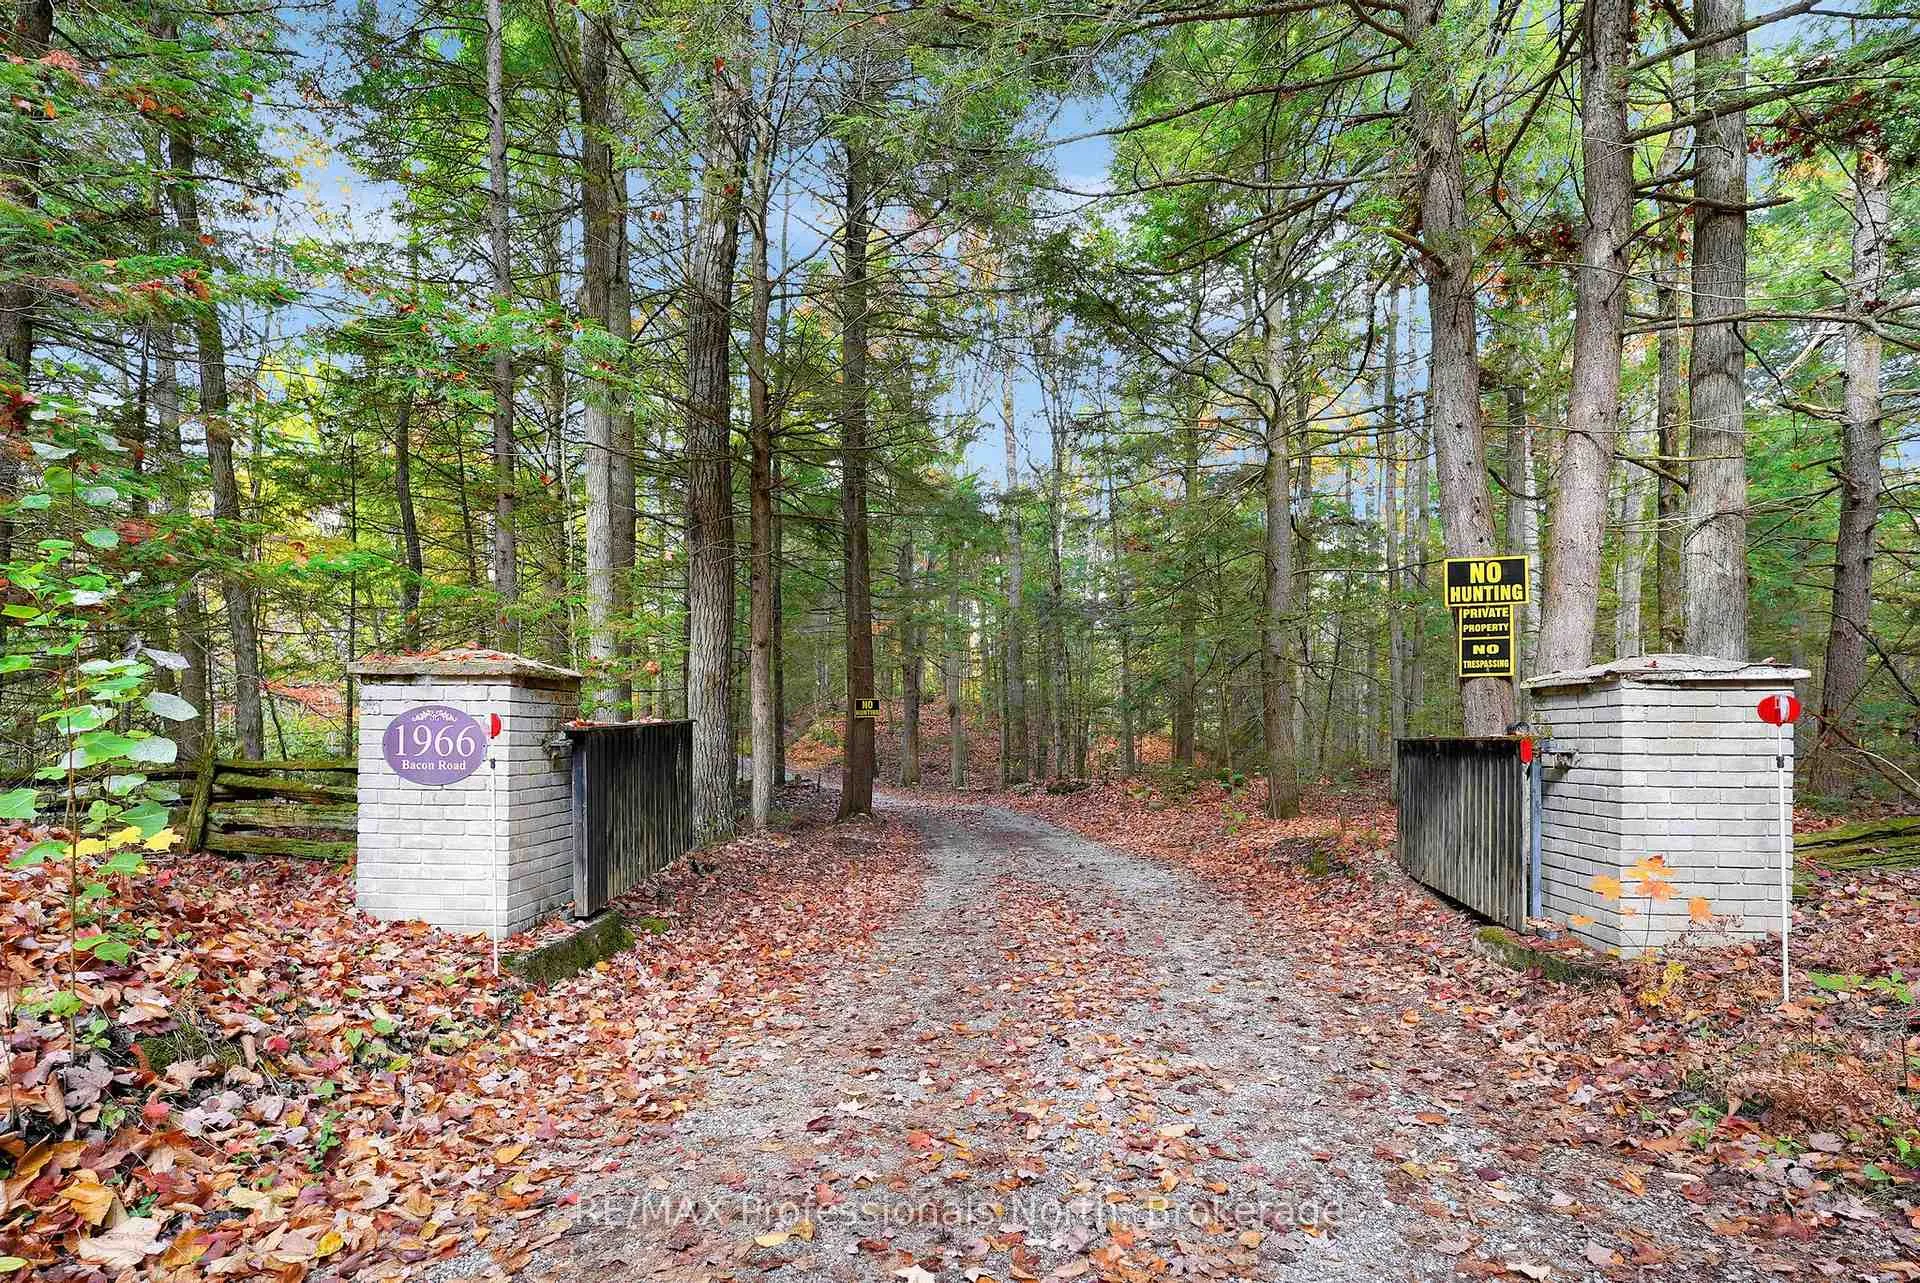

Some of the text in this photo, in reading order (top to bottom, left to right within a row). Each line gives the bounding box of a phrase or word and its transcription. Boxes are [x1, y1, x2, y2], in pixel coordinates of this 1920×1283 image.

[1469, 562, 1502, 584] NO
[1450, 584, 1523, 603] HUNTING
[1463, 607, 1509, 619] PRIVATE
[1463, 623, 1509, 633] PROPERTY
[1472, 644, 1500, 655] NO
[1463, 659, 1509, 669] TRESPASSING
[862, 700, 873, 709] NO
[394, 724, 477, 757] 1966
[401, 759, 466, 770] Bacon Road
